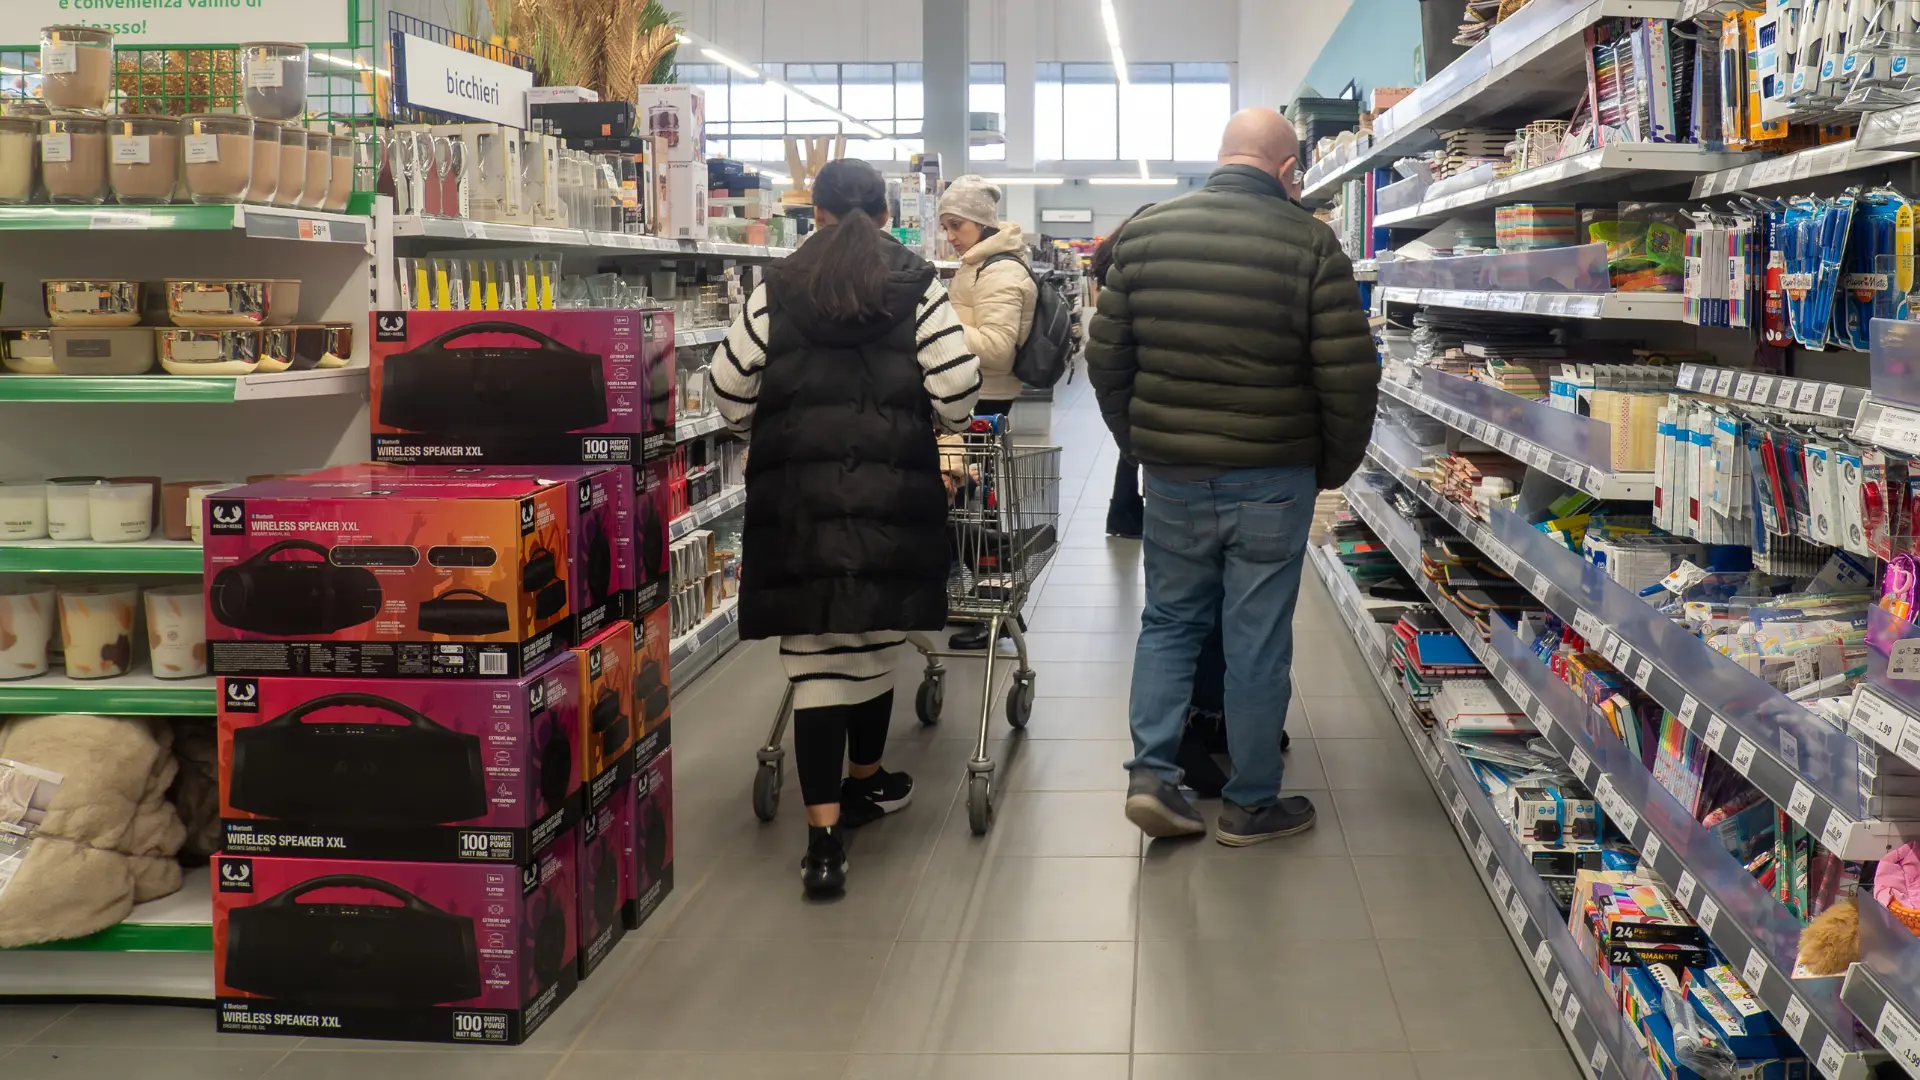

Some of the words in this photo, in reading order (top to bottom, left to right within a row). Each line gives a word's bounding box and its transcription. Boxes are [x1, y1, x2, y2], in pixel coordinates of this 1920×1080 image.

[446, 67, 499, 106] bicchieri
[377, 446, 421, 456] WIRELESS
[423, 446, 463, 456] SPEAKER
[465, 446, 484, 456] XXL
[584, 440, 608, 454] 100
[252, 521, 296, 532] WIRELESS
[298, 522, 339, 532] SPEAKER
[342, 522, 360, 532] XXL
[228, 833, 276, 846] WIRELESS
[278, 835, 324, 848] SPEAKER
[326, 837, 346, 848] XXL
[462, 834, 488, 850] 100
[1615, 926, 1634, 938] 24
[1613, 951, 1631, 963] 24
[223, 1012, 272, 1024] WIRELESS
[274, 1014, 319, 1026] SPEAKER
[322, 1016, 342, 1028] XXL
[456, 1015, 482, 1031] 100
